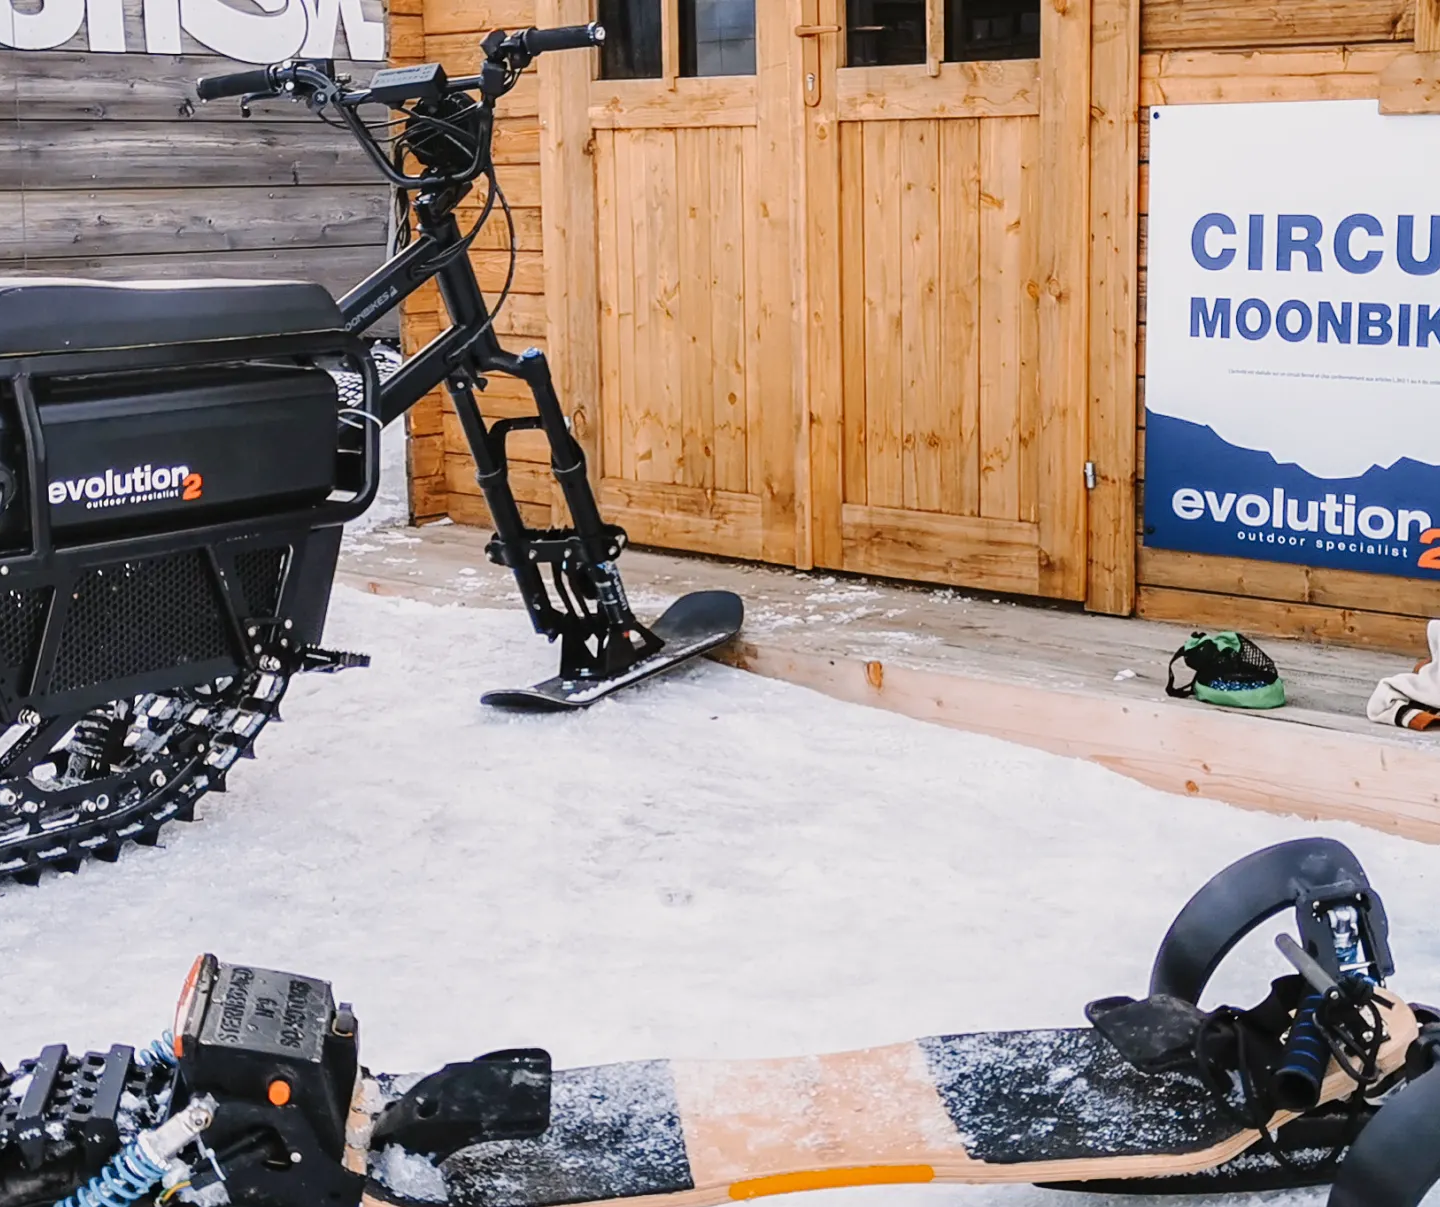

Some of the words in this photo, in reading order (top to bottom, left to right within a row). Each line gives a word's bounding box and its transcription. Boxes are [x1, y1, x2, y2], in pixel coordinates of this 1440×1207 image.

[344, 291, 390, 332] OONBIKES
[48, 464, 190, 504] evolution
[182, 473, 203, 500] 2
[86, 497, 126, 509] outdoor
[130, 489, 179, 504] specialist
[1171, 487, 1433, 541] evolution
[1237, 530, 1307, 548] outdoor
[1315, 538, 1409, 559] specialist
